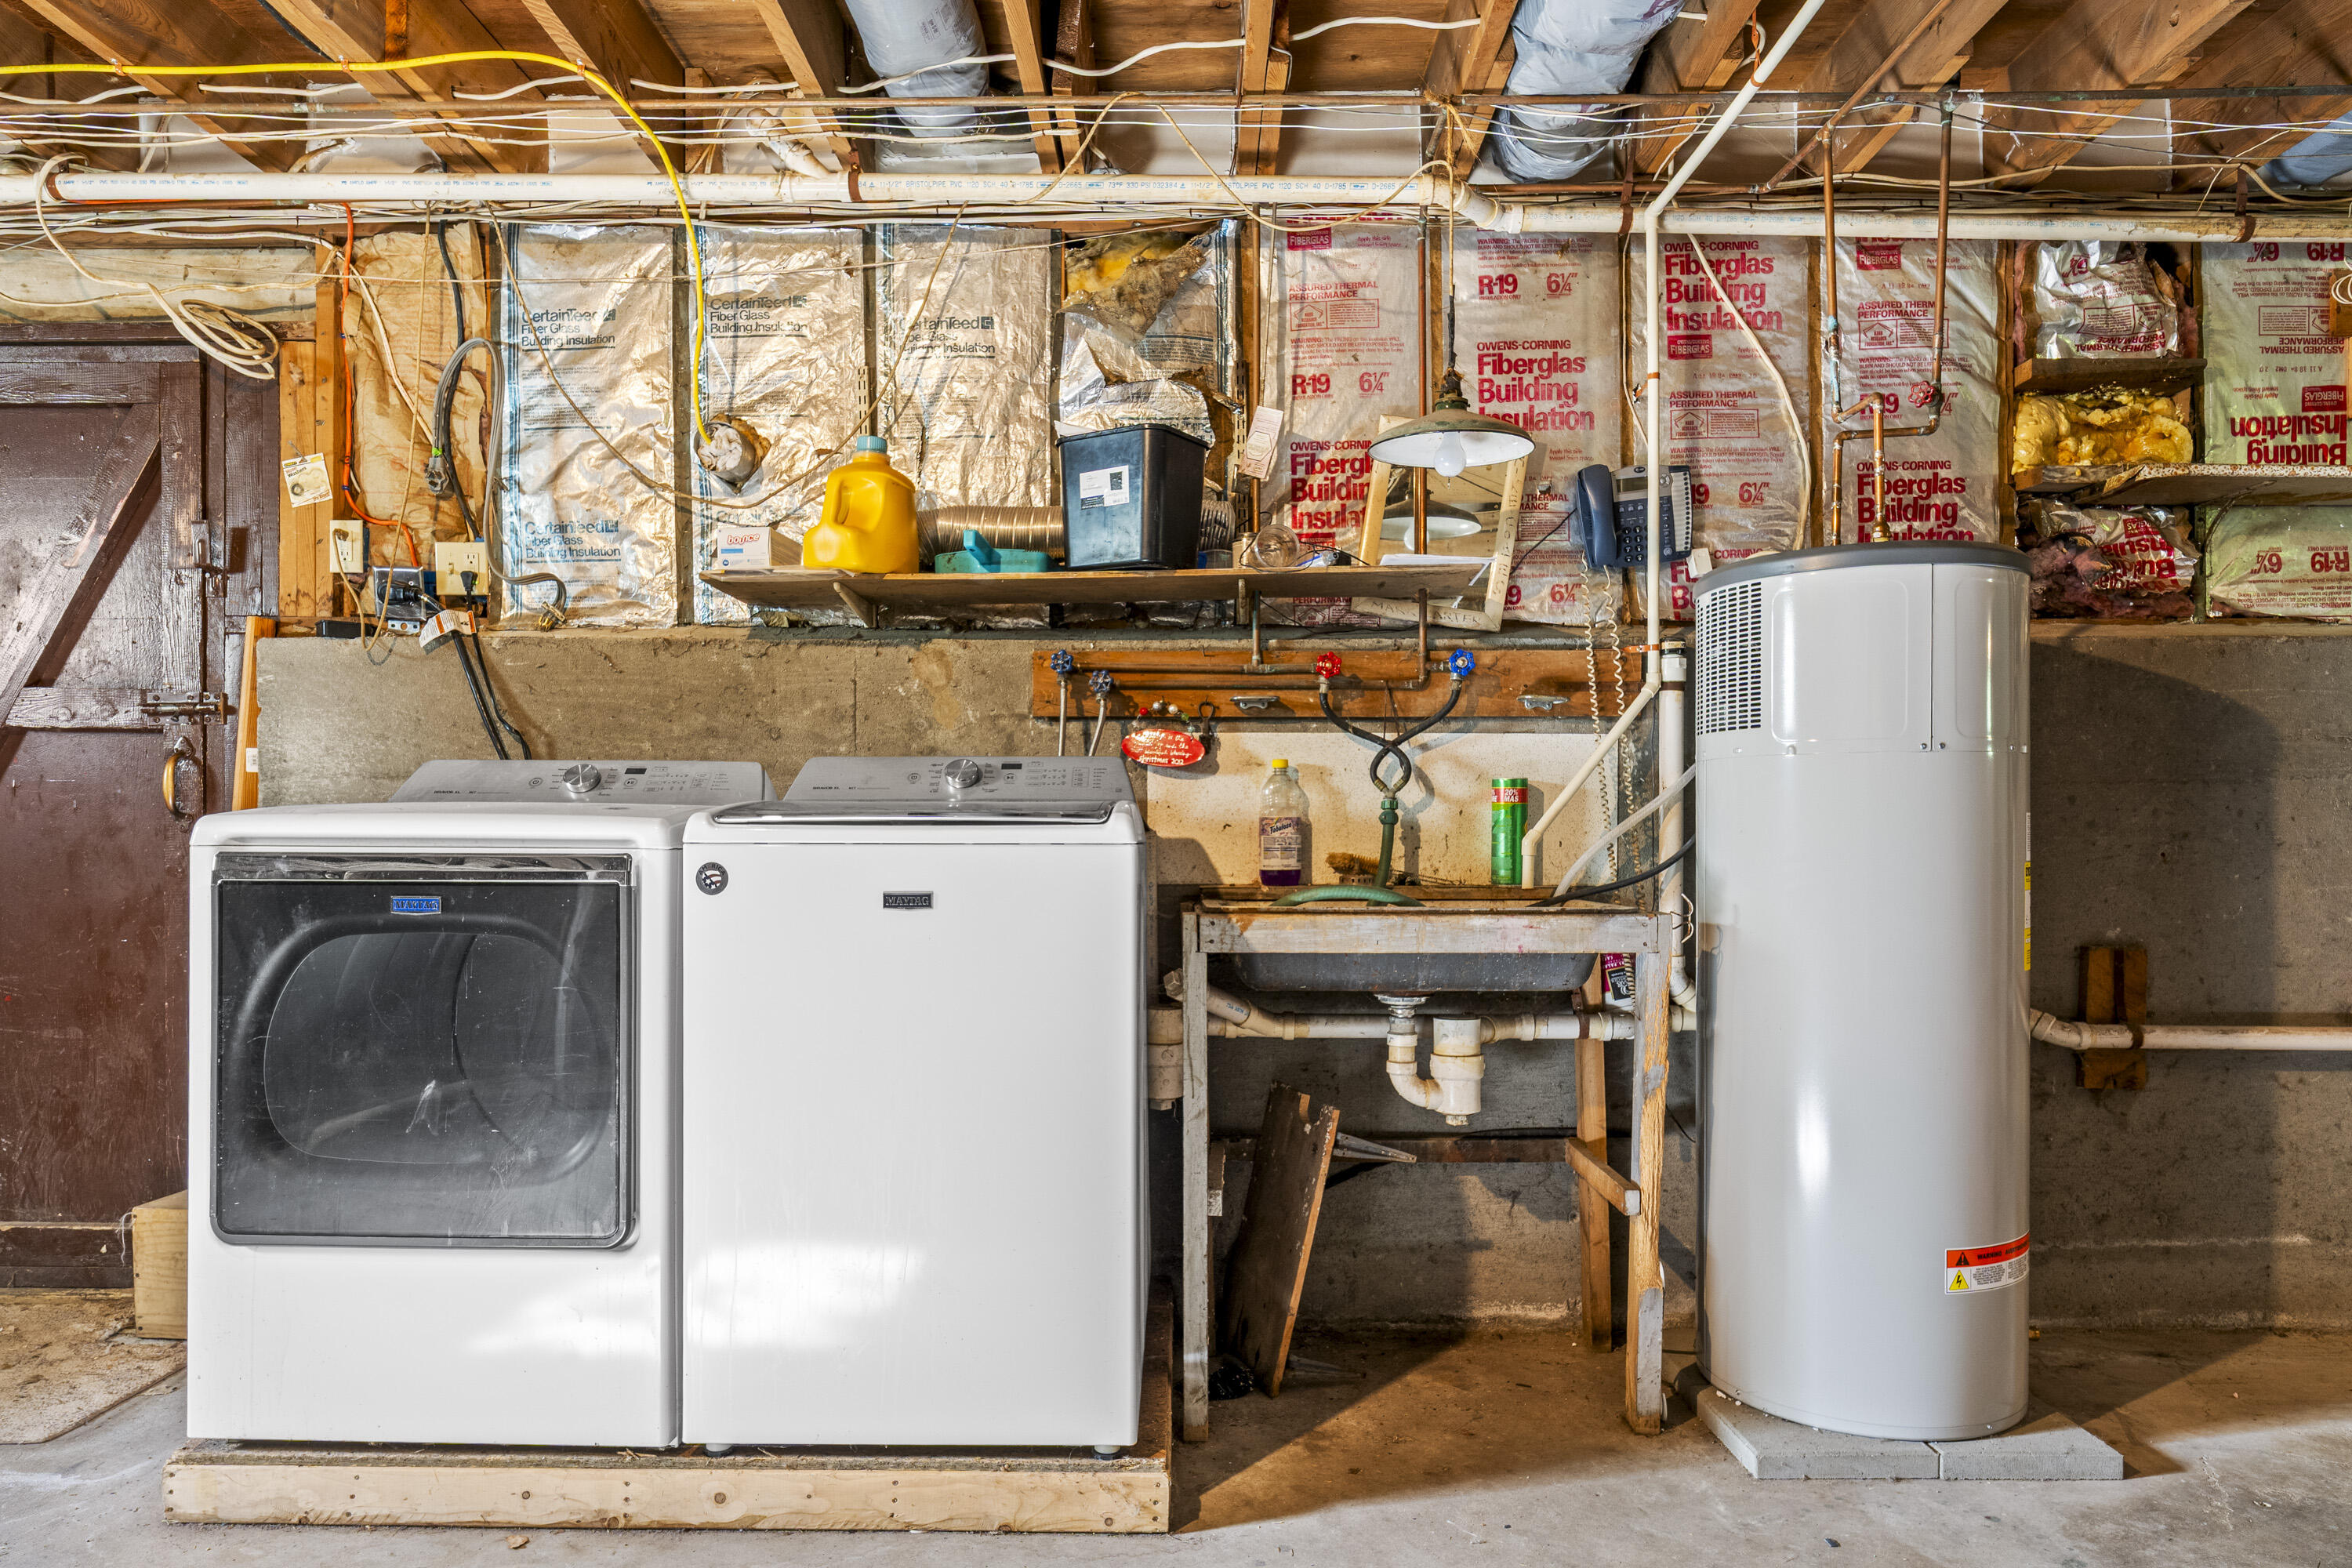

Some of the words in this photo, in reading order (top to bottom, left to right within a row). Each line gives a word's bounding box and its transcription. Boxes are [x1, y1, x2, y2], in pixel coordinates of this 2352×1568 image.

[1289, 235, 1330, 245] FIBERGLAS
[1859, 255, 1899, 264] FIBERGLAS
[1289, 282, 1332, 292] ASSURED
[1334, 281, 1378, 290] THERMAL
[1479, 274, 1518, 296] R-19
[1289, 291, 1358, 301] PERFORMANCE
[710, 296, 791, 310] CertainTeed
[1858, 301, 1902, 310] ASSURED
[710, 311, 737, 321] Fiber
[739, 310, 770, 320] Glass
[1858, 310, 1928, 318] PERFORMANCE
[710, 323, 755, 334] Building
[566, 335, 615, 346] Insulation
[2097, 332, 2165, 343] PERFORMANCE
[1477, 339, 1571, 351] OWENS-CORNING
[1670, 345, 1710, 354] FIBERGLAS
[2121, 340, 2165, 353] ASSURED
[1478, 351, 1587, 379] Fiberglas
[1292, 373, 1330, 395] R-19
[1478, 376, 1578, 408] Building
[1715, 390, 1758, 399] THERMAL
[2305, 390, 2343, 401] FIBERGLAS
[2230, 414, 2347, 442] Insulation
[1290, 440, 1372, 451] OWENS-CORNIN
[2248, 438, 2347, 465] Building
[1290, 452, 1372, 479] Fibergl
[1290, 477, 1370, 502] Buildin
[726, 533, 760, 546] bounce
[569, 547, 621, 557] Insulation
[2310, 551, 2350, 572] R-19
[1269, 822, 1293, 835] Fabuloso
[698, 862, 727, 877] AMERICA
[394, 901, 438, 910] MAYTAG
[884, 896, 931, 906] MAYTAG
[1976, 1250, 2002, 1261] WARNING
